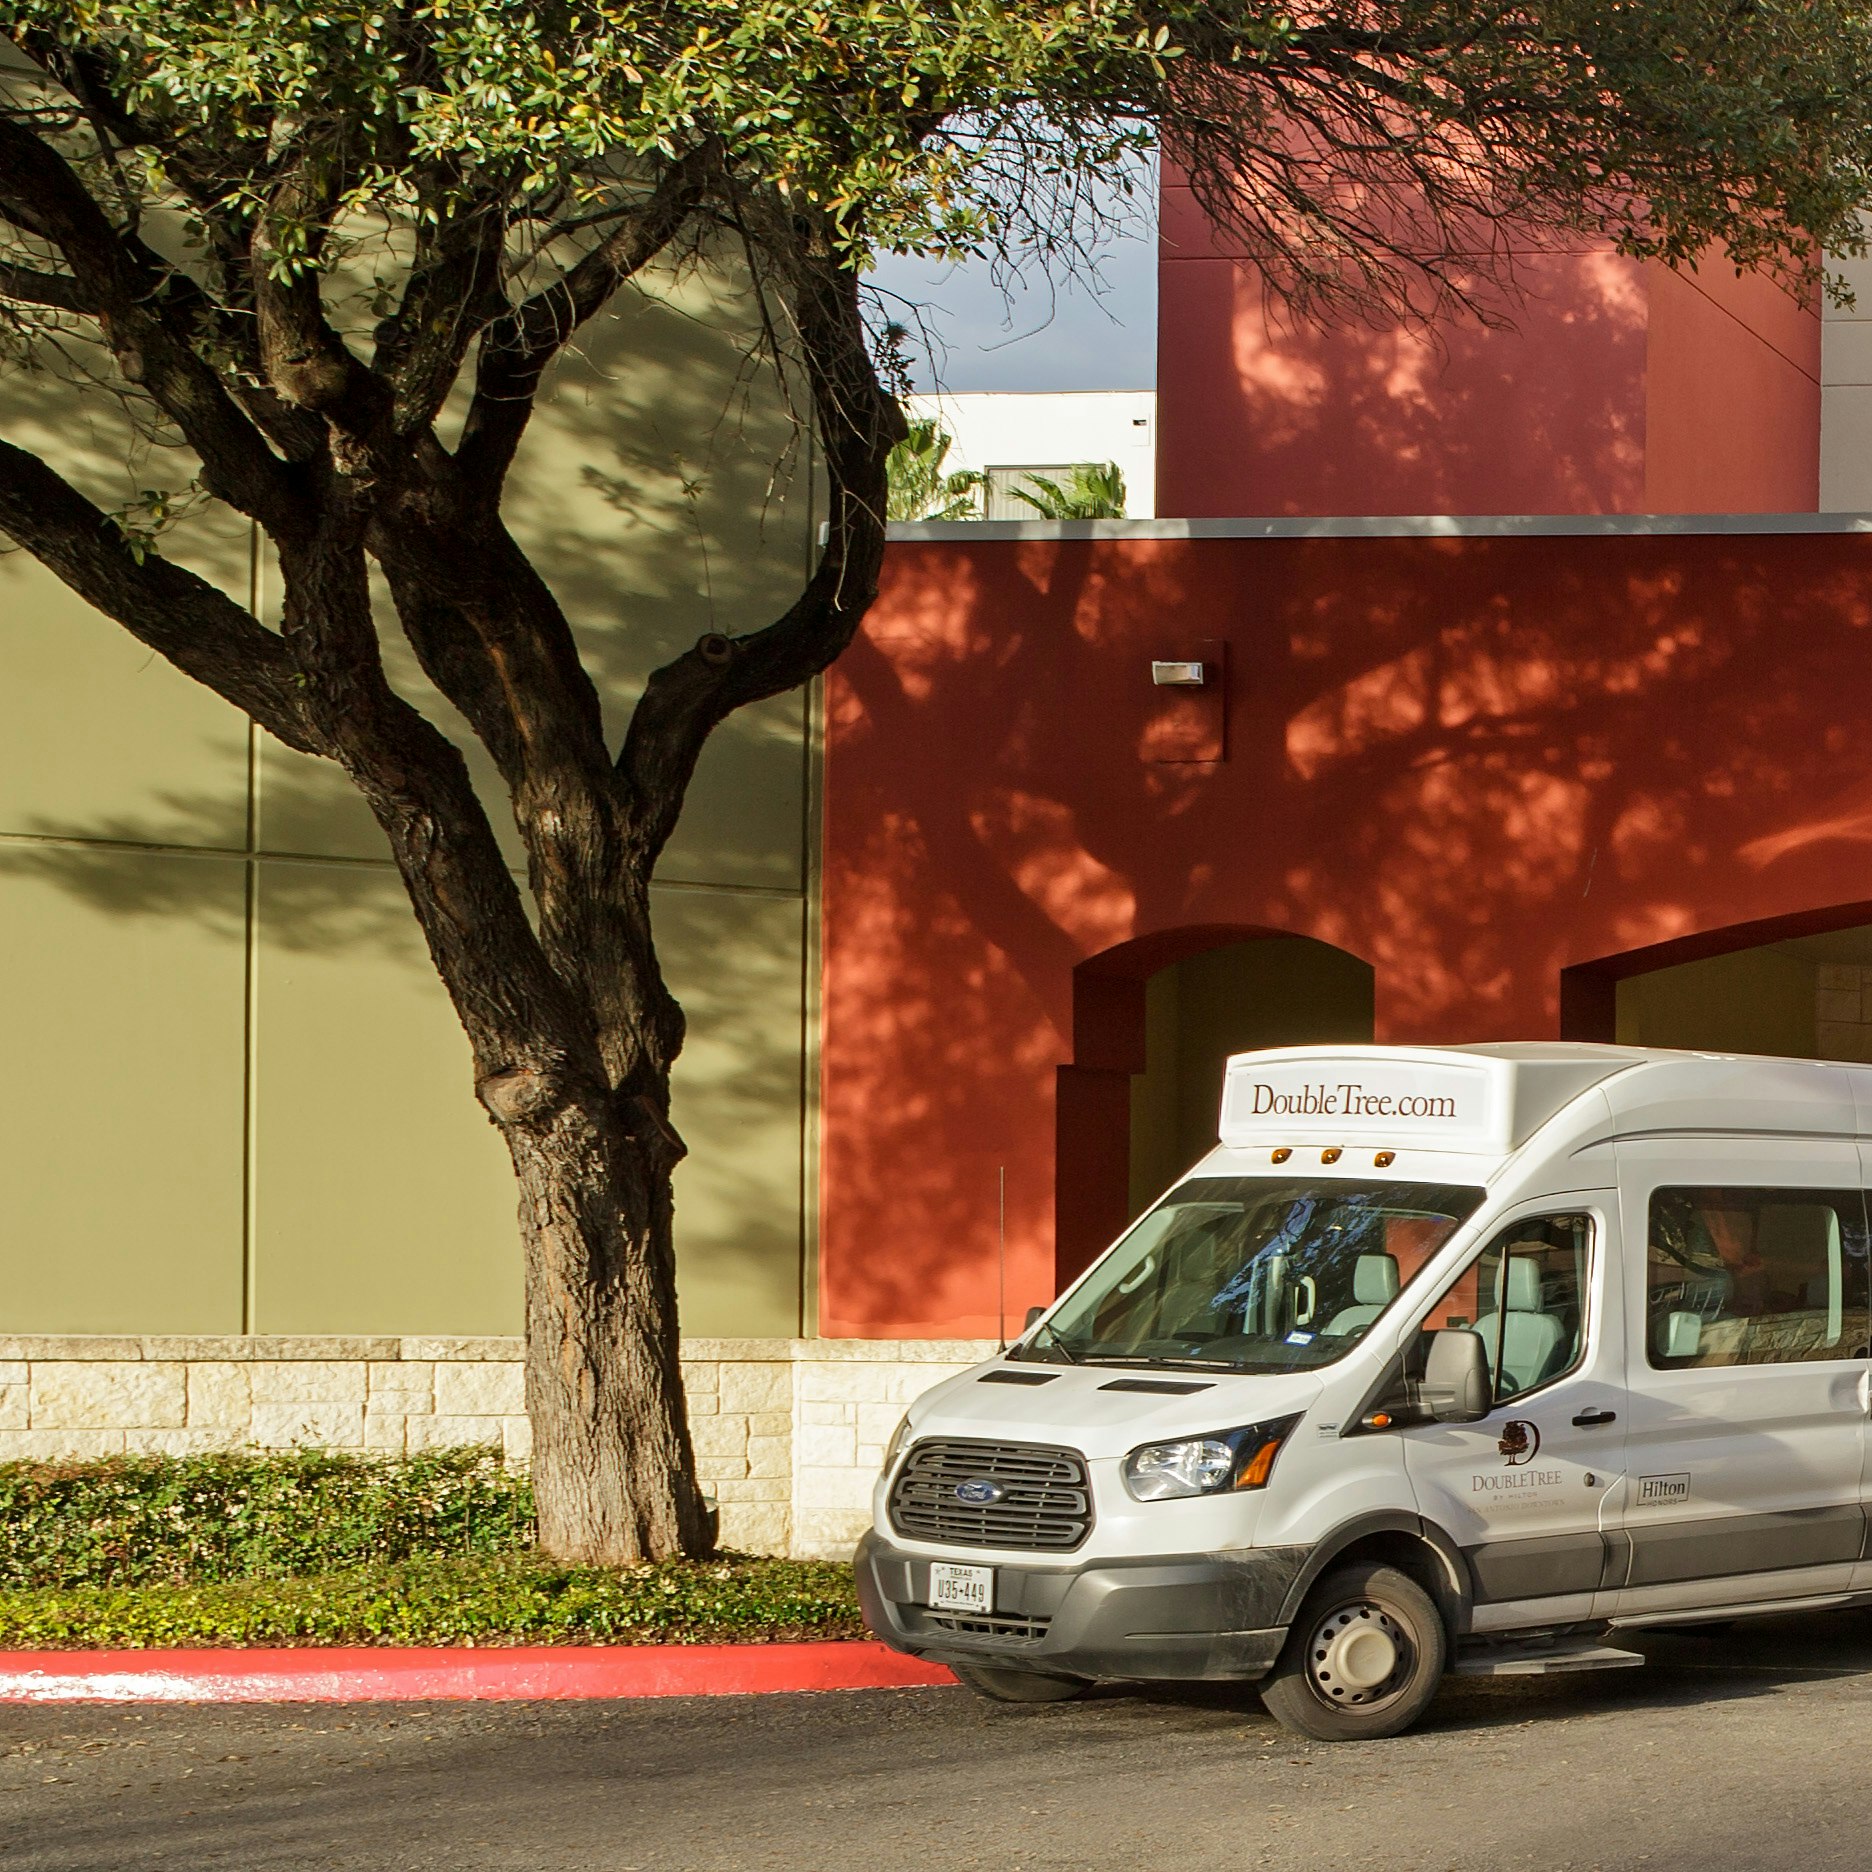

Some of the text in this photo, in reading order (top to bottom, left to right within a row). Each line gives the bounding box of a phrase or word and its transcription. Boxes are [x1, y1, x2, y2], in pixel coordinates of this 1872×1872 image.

[1250, 1084, 1457, 1117] DoubleTree.com
[1472, 1470, 1563, 1492] DOUBLETREE
[1642, 1480, 1686, 1498] Hilton
[949, 1567, 973, 1577] TEXAS
